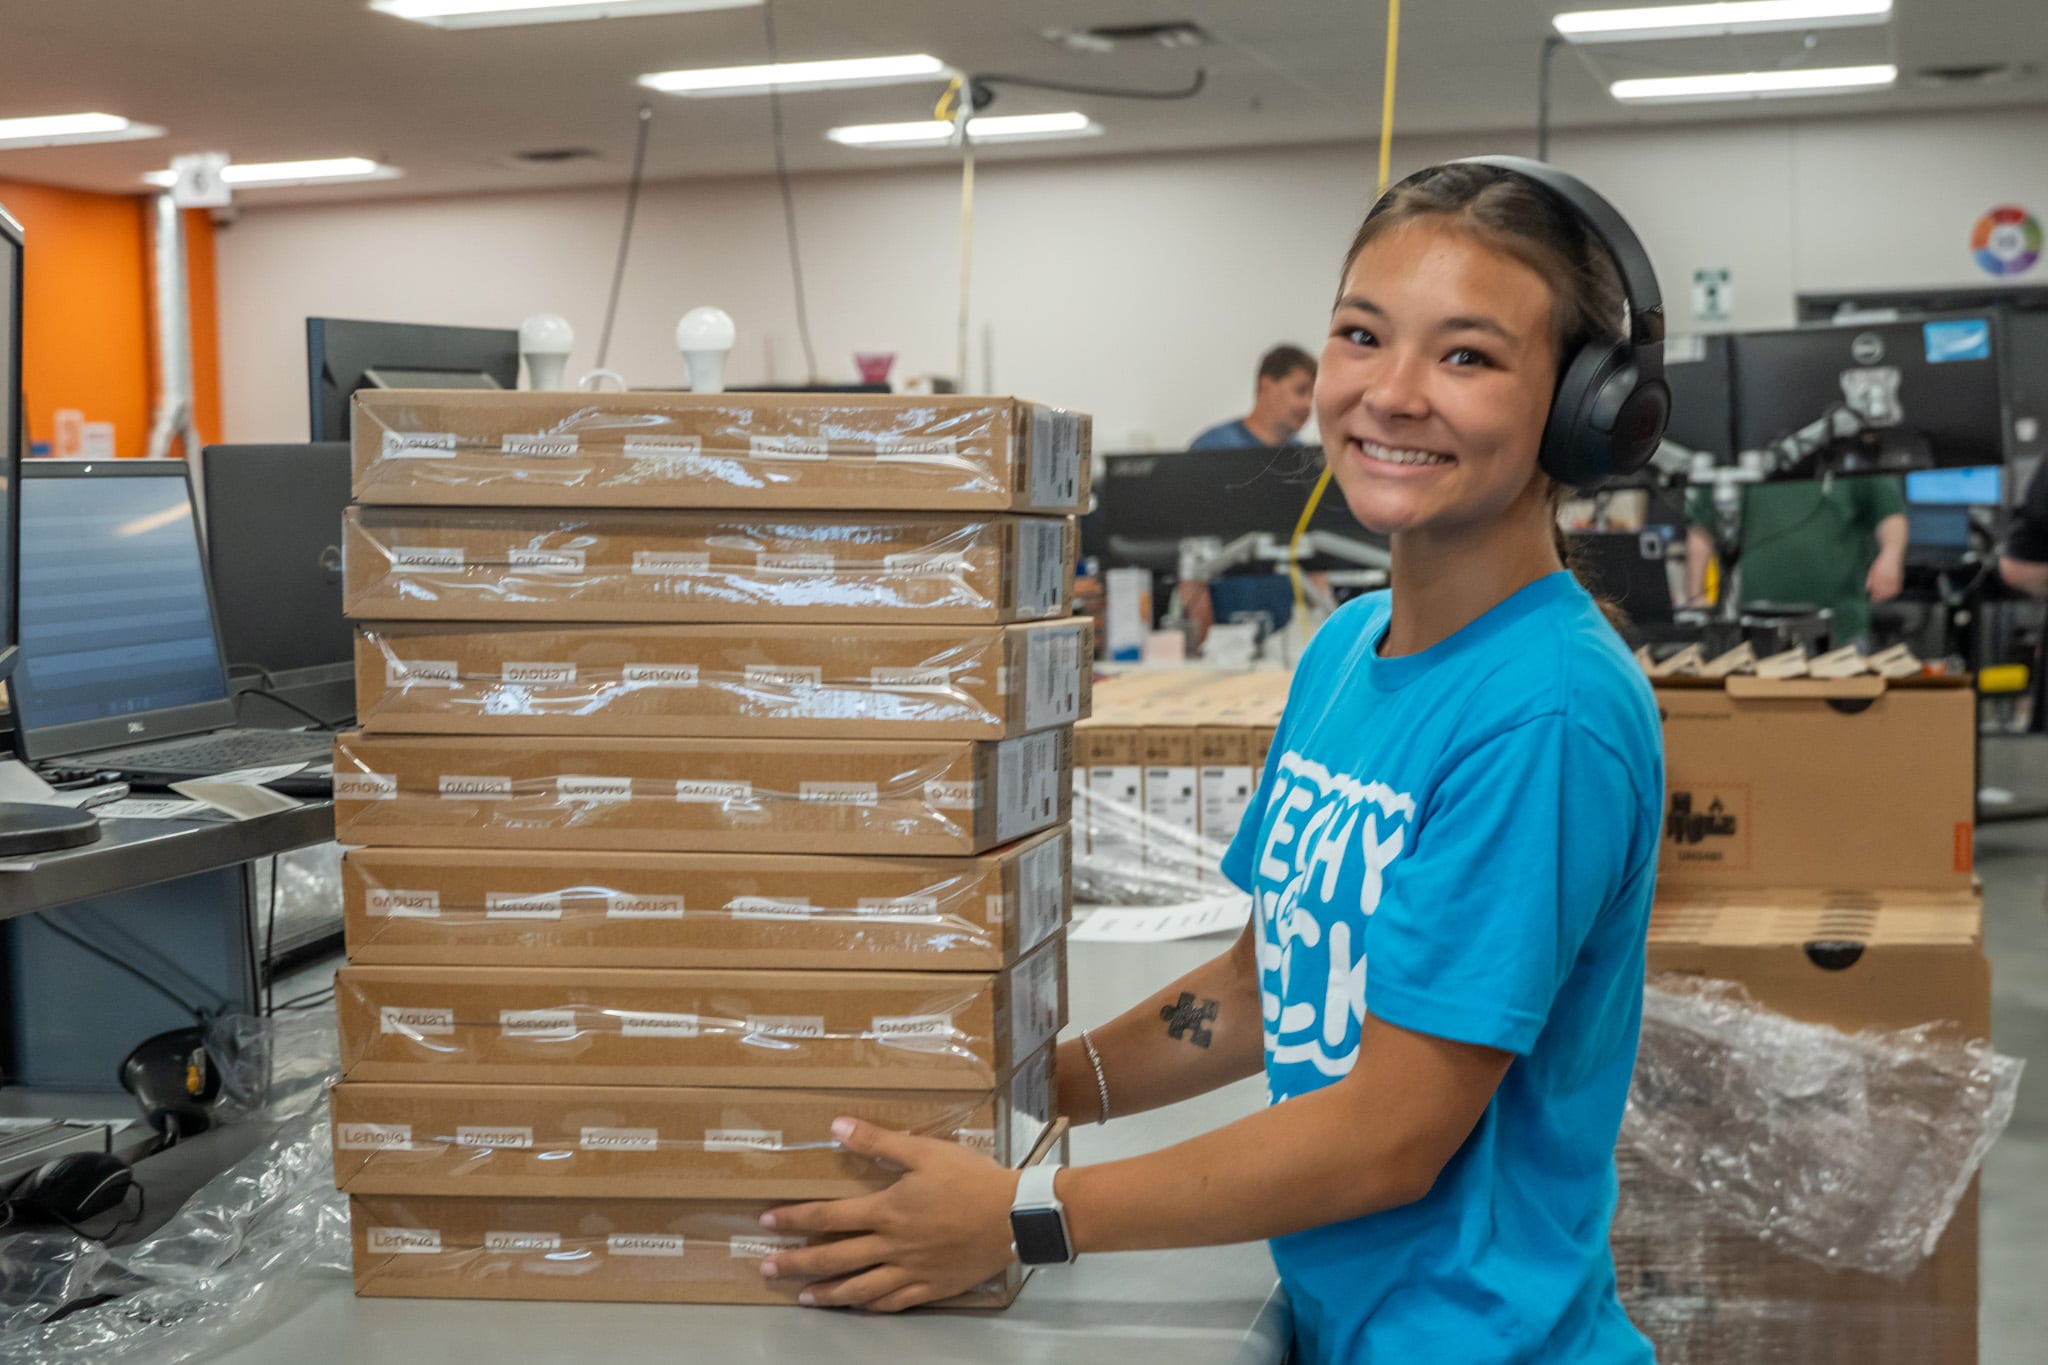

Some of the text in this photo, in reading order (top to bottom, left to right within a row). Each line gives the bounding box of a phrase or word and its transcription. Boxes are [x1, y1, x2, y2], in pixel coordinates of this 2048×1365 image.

[509, 440, 571, 454] Lenovo
[397, 554, 457, 566] Lenovo
[392, 667, 450, 681] Lenovo
[509, 668, 569, 681] Lenovo
[629, 668, 691, 681] Lenovo
[445, 782, 504, 793] Lenovo
[564, 784, 625, 795] Lenovo
[682, 785, 743, 799] Lenovo
[372, 896, 433, 909] Lenovo
[614, 899, 677, 911] Lenovo
[387, 1013, 447, 1026] Lenovo
[344, 1129, 404, 1144] Lenovo
[463, 1133, 526, 1147] Lenovo
[588, 1134, 650, 1145] Lenovo
[375, 1233, 433, 1248] Lenovo
